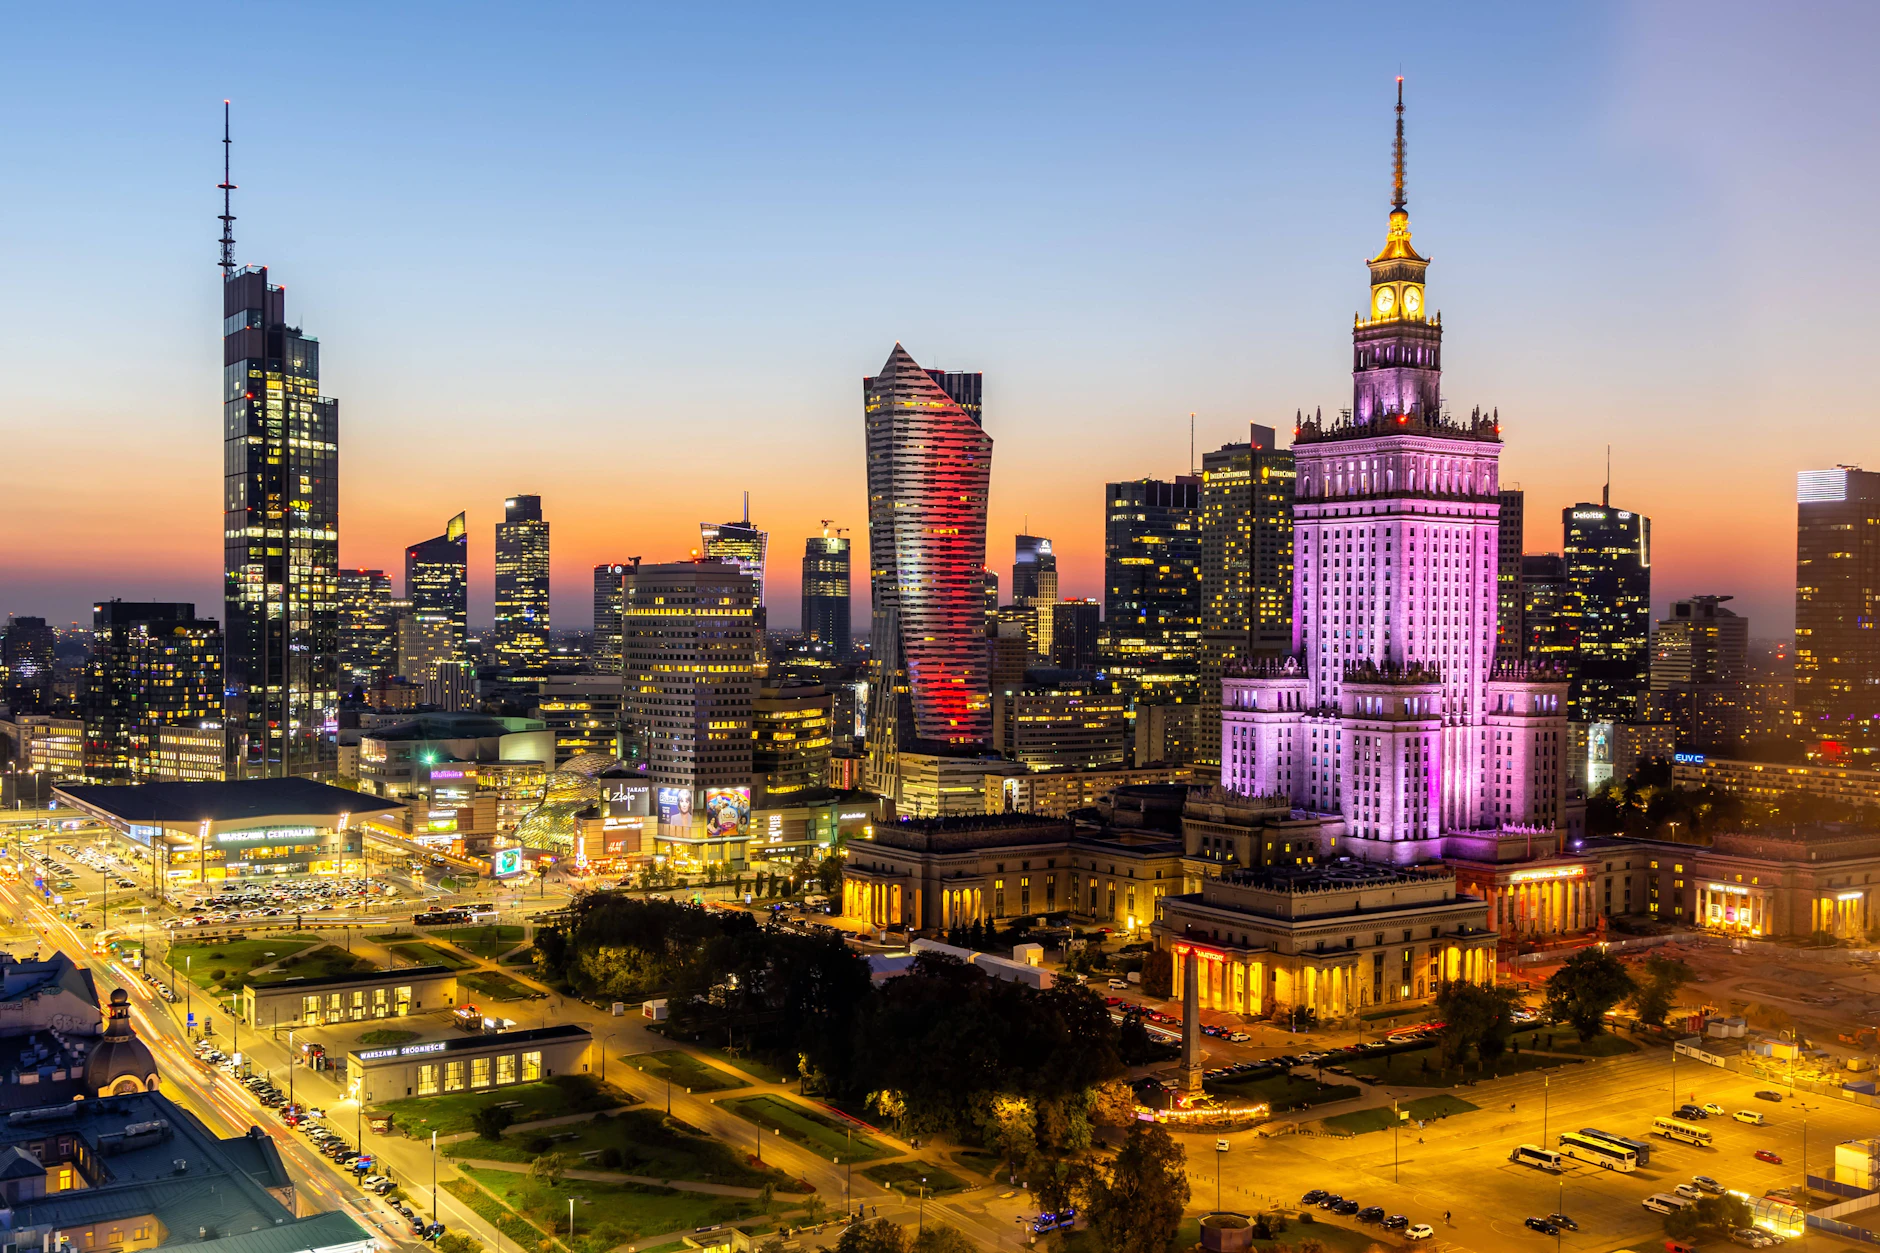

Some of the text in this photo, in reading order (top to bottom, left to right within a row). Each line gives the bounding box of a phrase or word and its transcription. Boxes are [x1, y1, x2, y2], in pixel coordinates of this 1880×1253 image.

[217, 828, 316, 842] WARSZAWA CENTRALNA
[360, 1042, 446, 1060] WARSZAWA ŚRÓDMIEŚCIE
